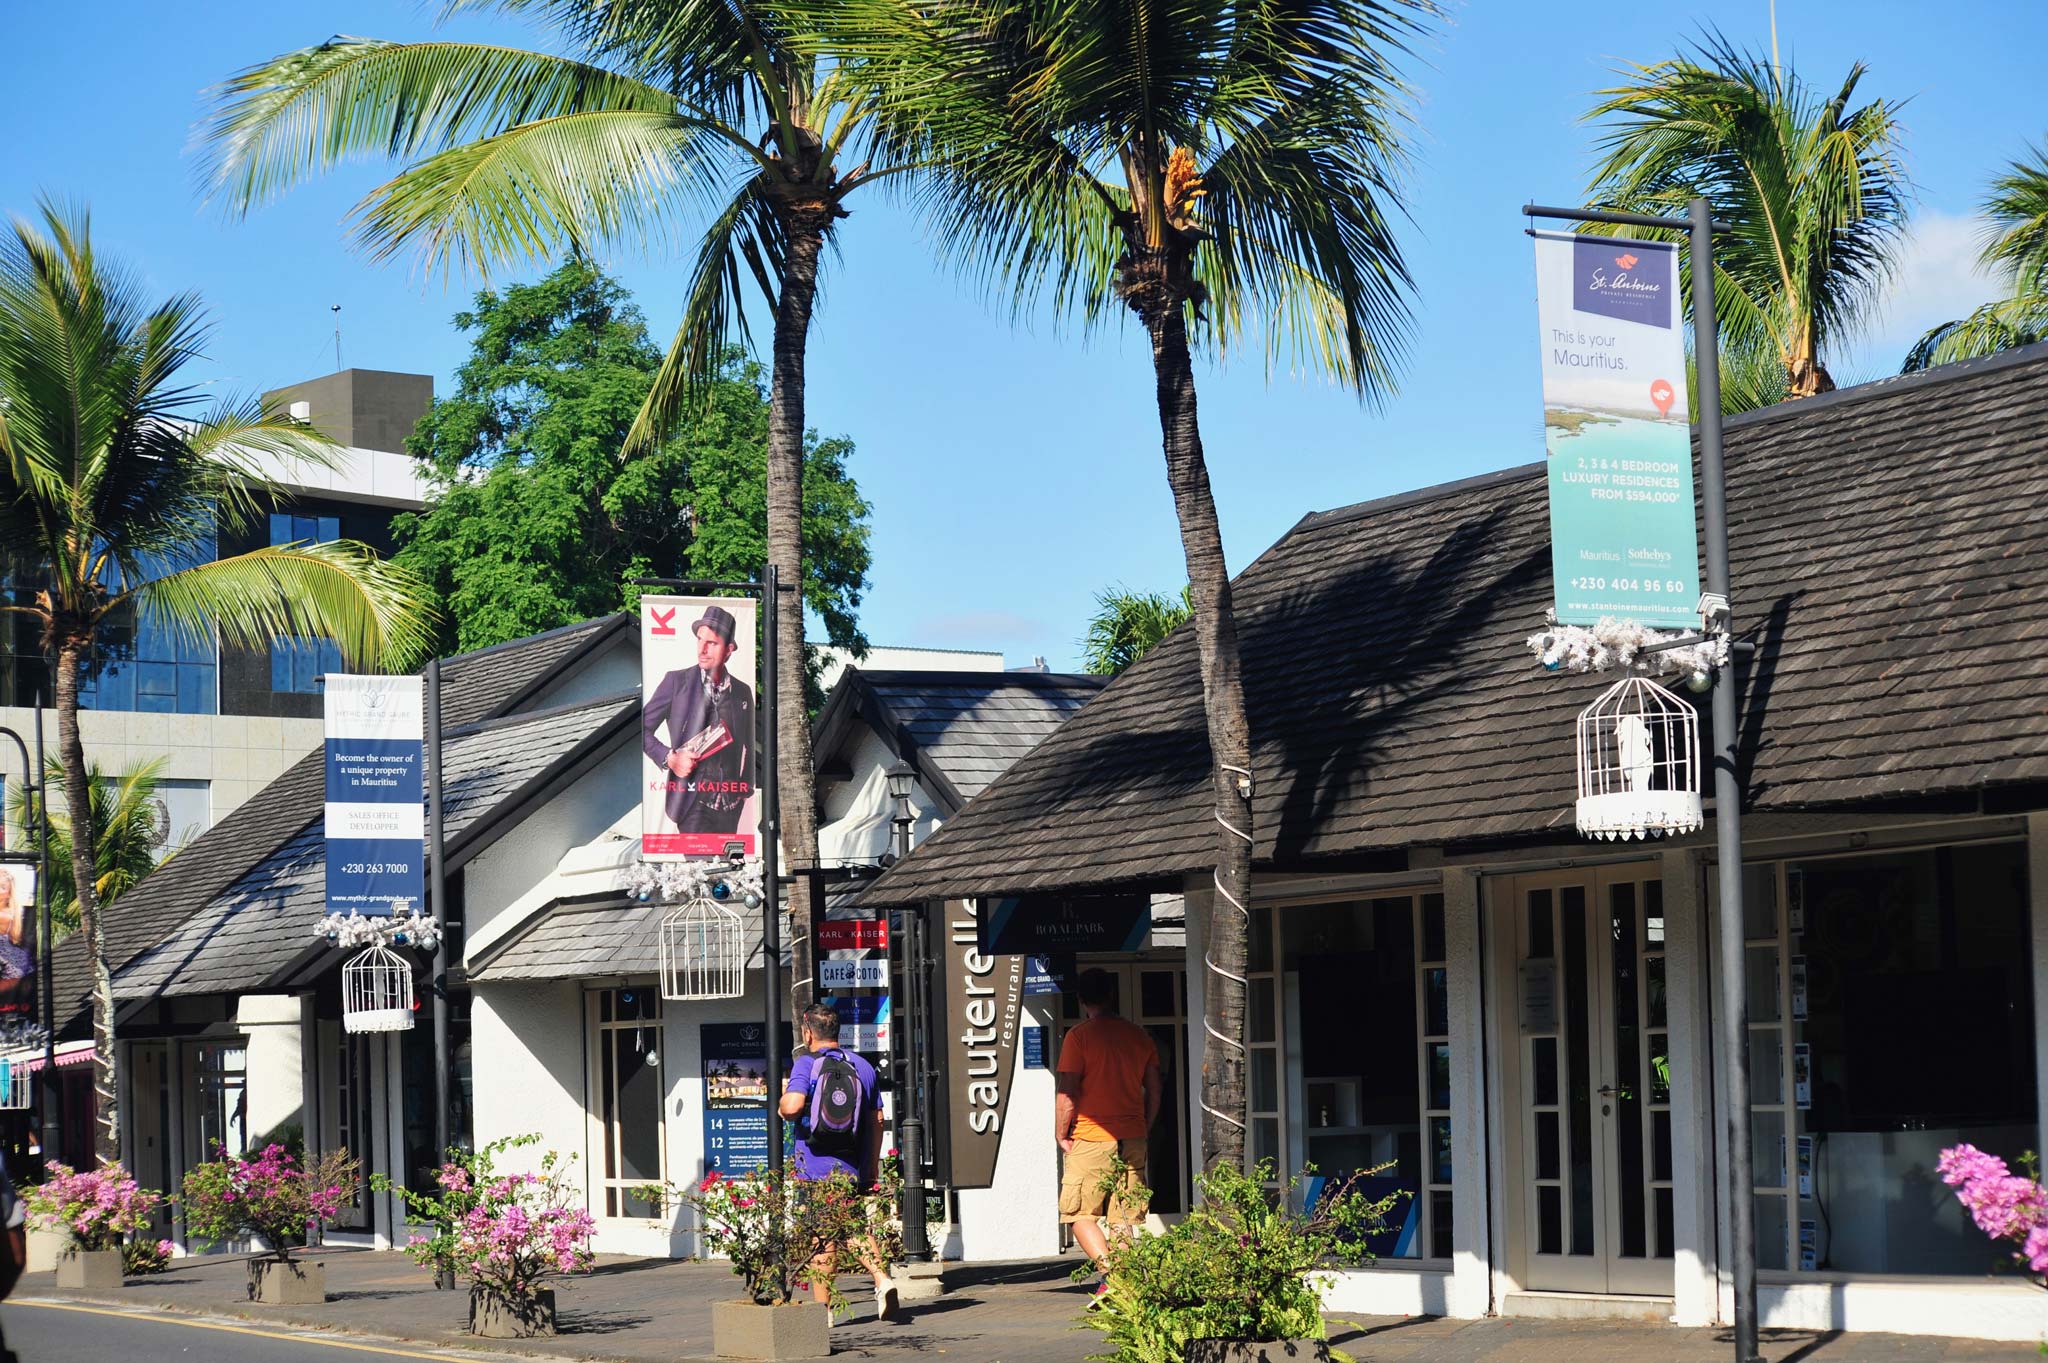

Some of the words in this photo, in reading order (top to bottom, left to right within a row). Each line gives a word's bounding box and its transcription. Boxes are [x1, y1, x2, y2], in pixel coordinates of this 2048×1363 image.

[1609, 272, 1660, 291] Antoine
[1552, 328, 1575, 344] This
[1578, 330, 1586, 345] is
[1589, 335, 1616, 348] your
[1554, 349, 1628, 370] Mauritius.
[1577, 457, 1588, 470] 2,
[1591, 458, 1598, 469] 3
[1600, 459, 1608, 469] &
[1610, 459, 1619, 470] 4
[1621, 460, 1679, 473] BEDROOM
[1562, 471, 1609, 484] LUXURY
[1612, 474, 1680, 488] RESIDENCES
[1591, 488, 1623, 500] FROM
[1580, 549, 1620, 561] Mauritius
[1570, 577, 1606, 590] +230
[1611, 578, 1639, 590] 404
[1643, 579, 1661, 592] 96
[1666, 580, 1684, 593] 60
[1568, 602, 1690, 613] www.stantoinemauritius.com
[335, 753, 365, 762] Become
[366, 753, 379, 762] the
[380, 755, 404, 763] owner
[404, 753, 415, 763] of
[347, 766, 374, 776] unique
[374, 767, 408, 777] property
[351, 777, 360, 786] in
[361, 778, 398, 786] Mauritius
[649, 781, 686, 792] KARL
[697, 781, 749, 793] KAISER
[349, 811, 371, 820] SALES
[372, 811, 400, 820] OFFICE
[341, 863, 364, 874] +230
[366, 863, 383, 874] 263
[385, 863, 408, 874] 7000
[819, 930, 843, 938] KARL
[851, 930, 885, 938] KAISER
[1035, 923, 1071, 936] ROYAL
[1075, 922, 1105, 934] PARK
[856, 967, 884, 980] COTON
[1002, 955, 1021, 1048] restaurant
[711, 1118, 723, 1130] 14
[711, 1137, 724, 1149] 12
[713, 1155, 721, 1167] 3
